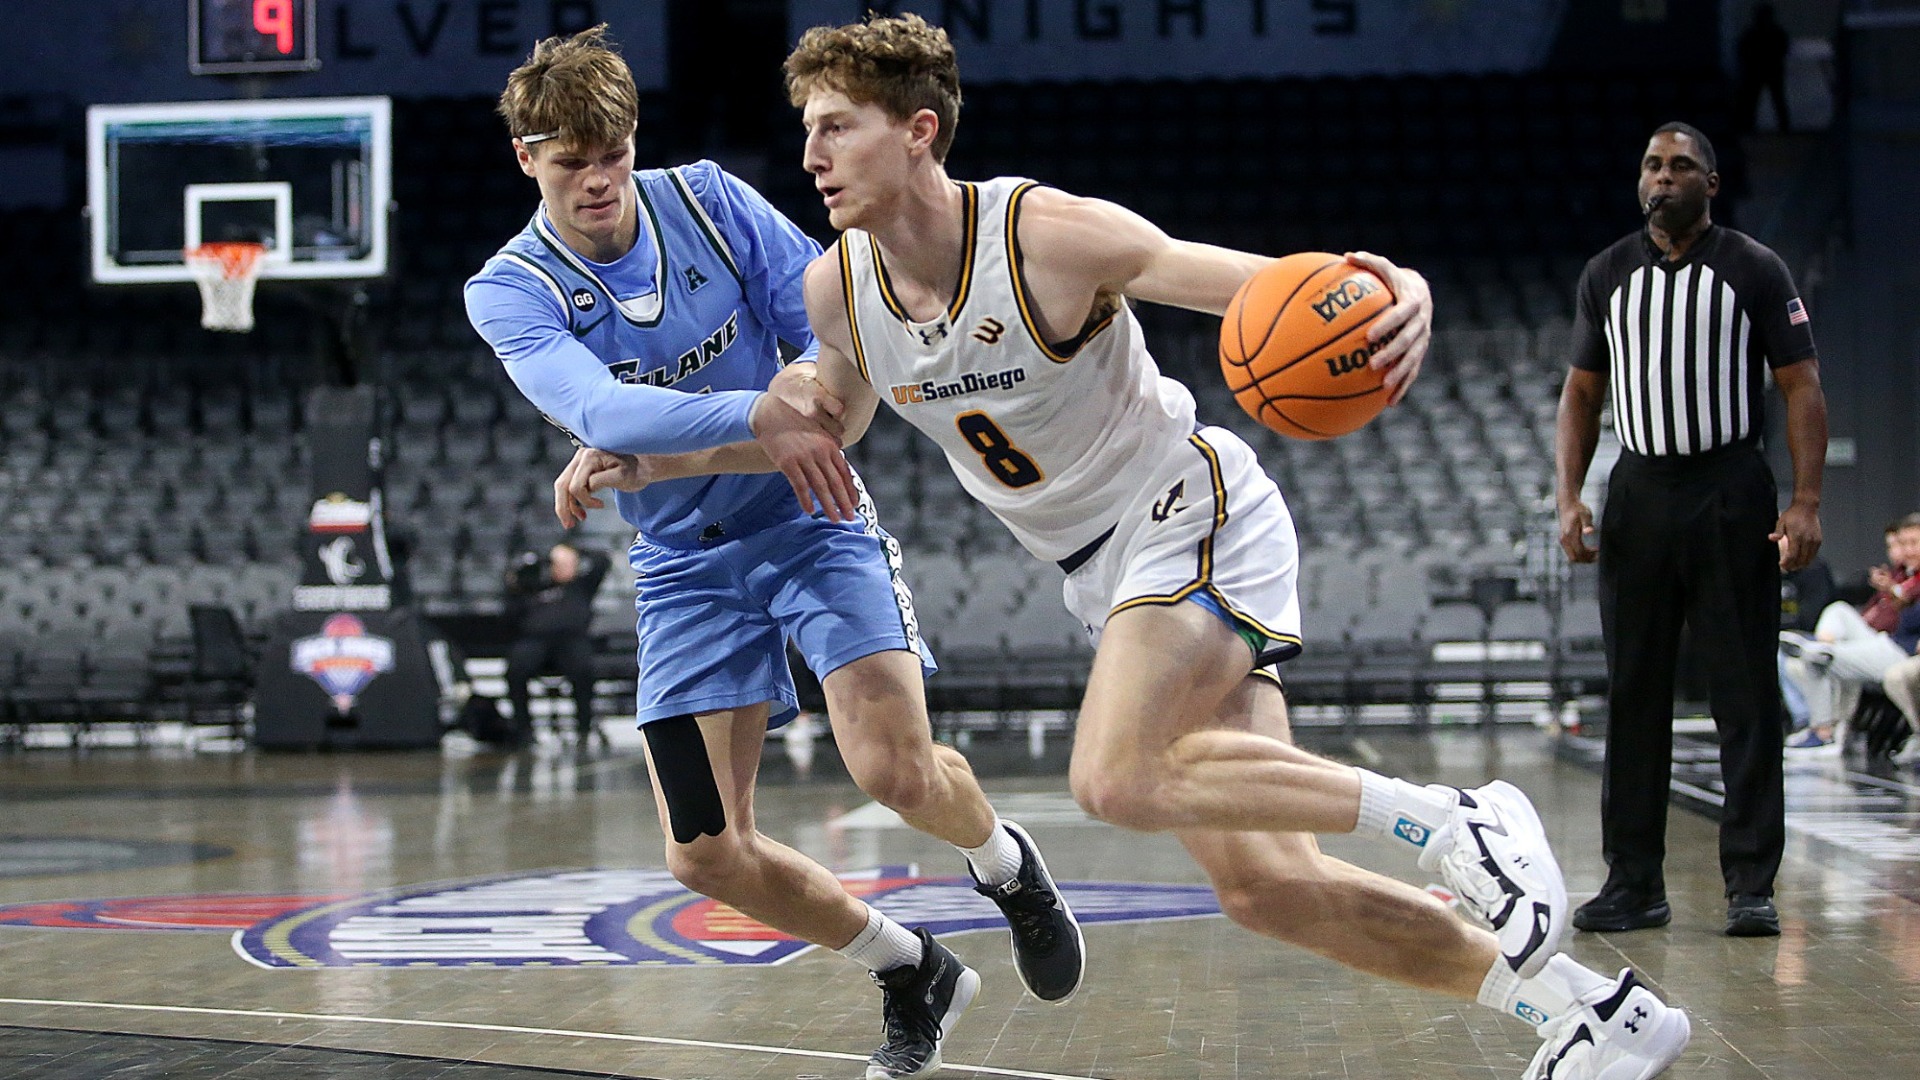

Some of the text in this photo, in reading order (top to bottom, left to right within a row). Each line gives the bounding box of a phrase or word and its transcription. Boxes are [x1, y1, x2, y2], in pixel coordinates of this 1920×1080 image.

[252, 0, 295, 55] 9
[573, 291, 595, 308] GG
[954, 408, 1046, 490] 8
